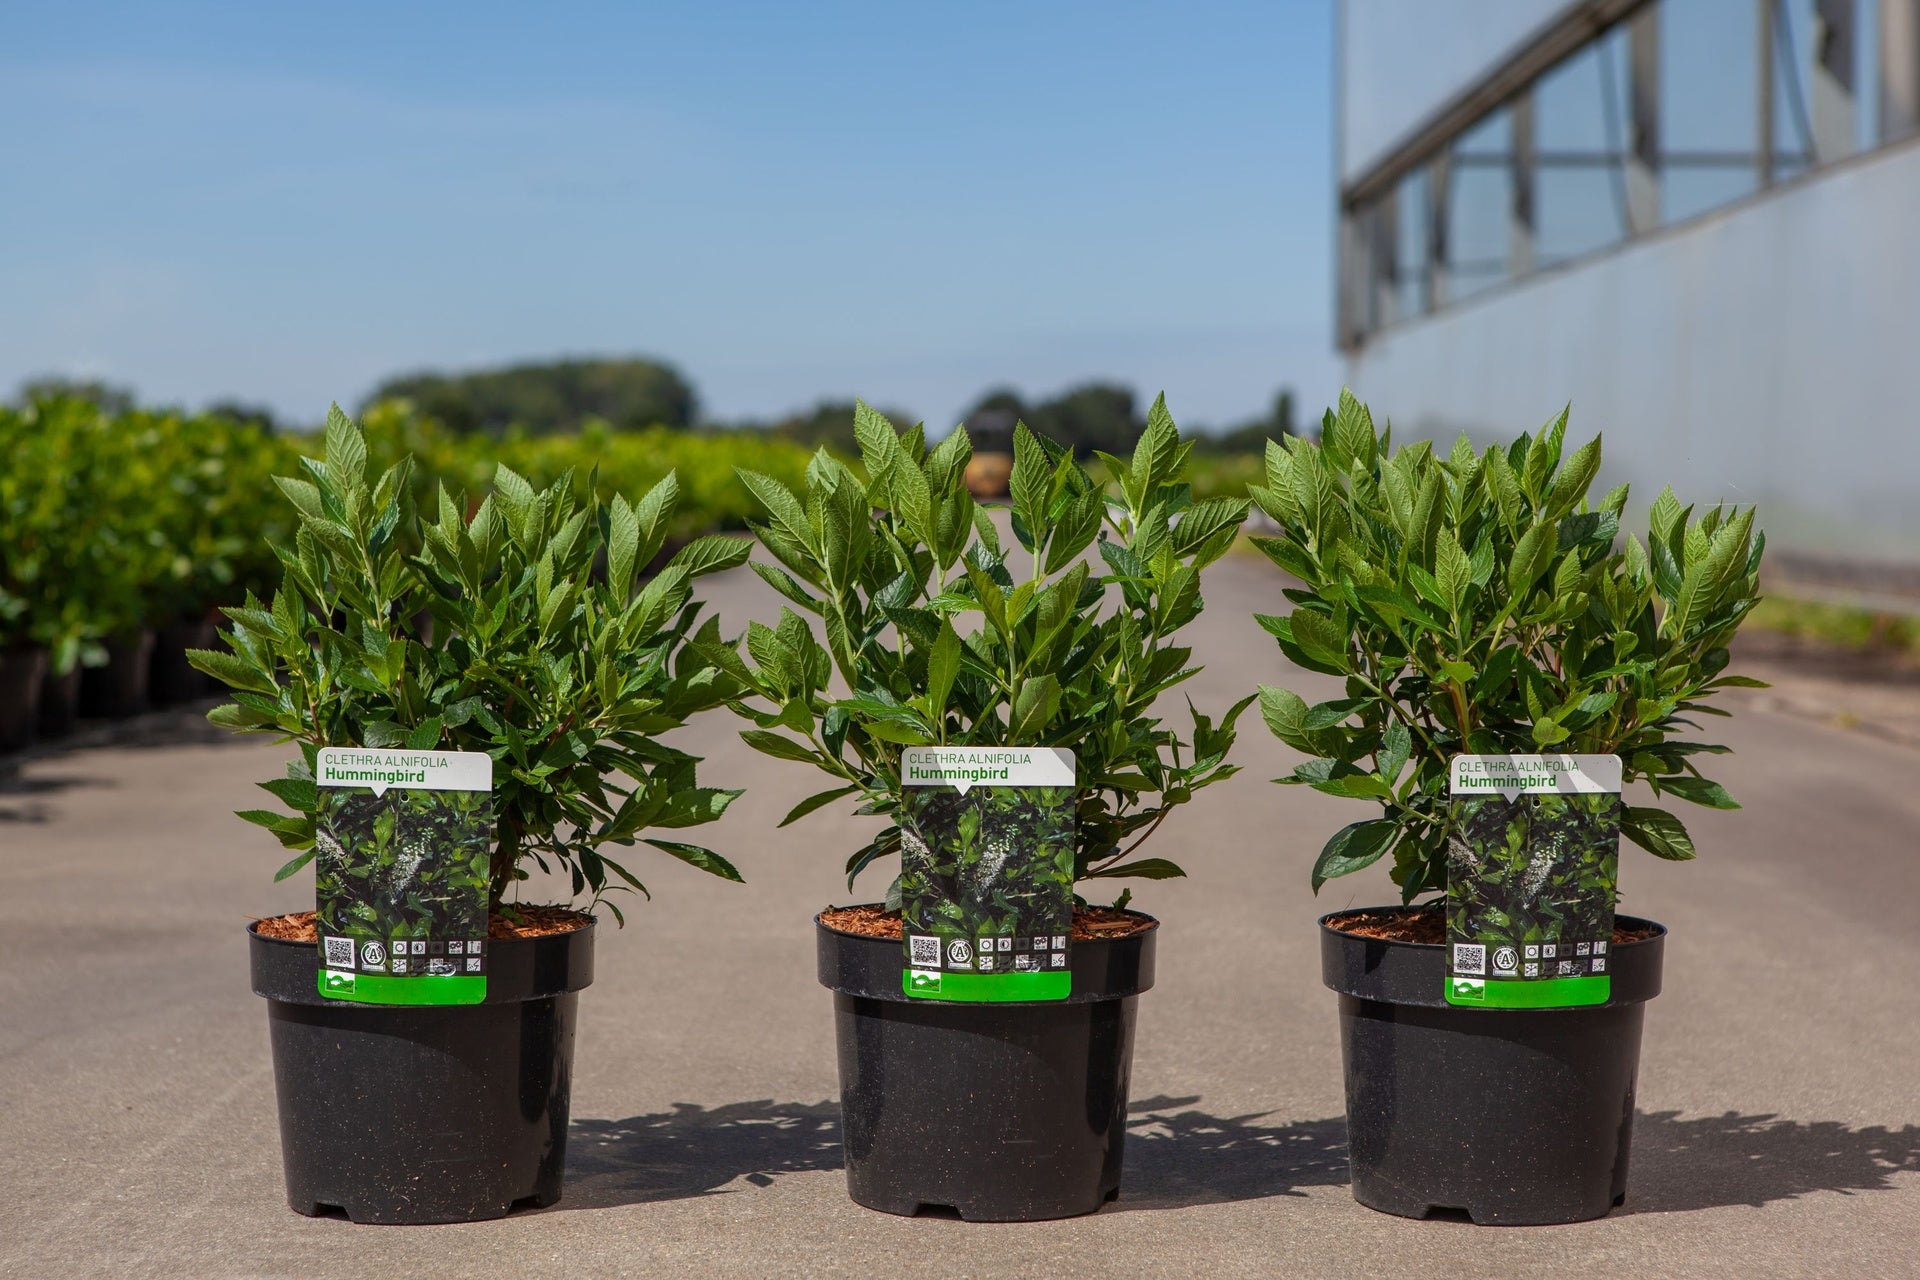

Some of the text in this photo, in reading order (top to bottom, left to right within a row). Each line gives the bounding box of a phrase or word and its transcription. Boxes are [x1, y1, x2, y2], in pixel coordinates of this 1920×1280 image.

[325, 754, 449, 768] CLETHRA ALNIFOLIA
[909, 753, 1032, 765] CLETHRA ALNIFOLIA
[1459, 760, 1580, 773] CLETHRA ALNIFOLIA
[325, 767, 425, 785] Hummingbird
[909, 766, 1009, 782] Hummingbird
[1459, 774, 1557, 790] Hummingbird
